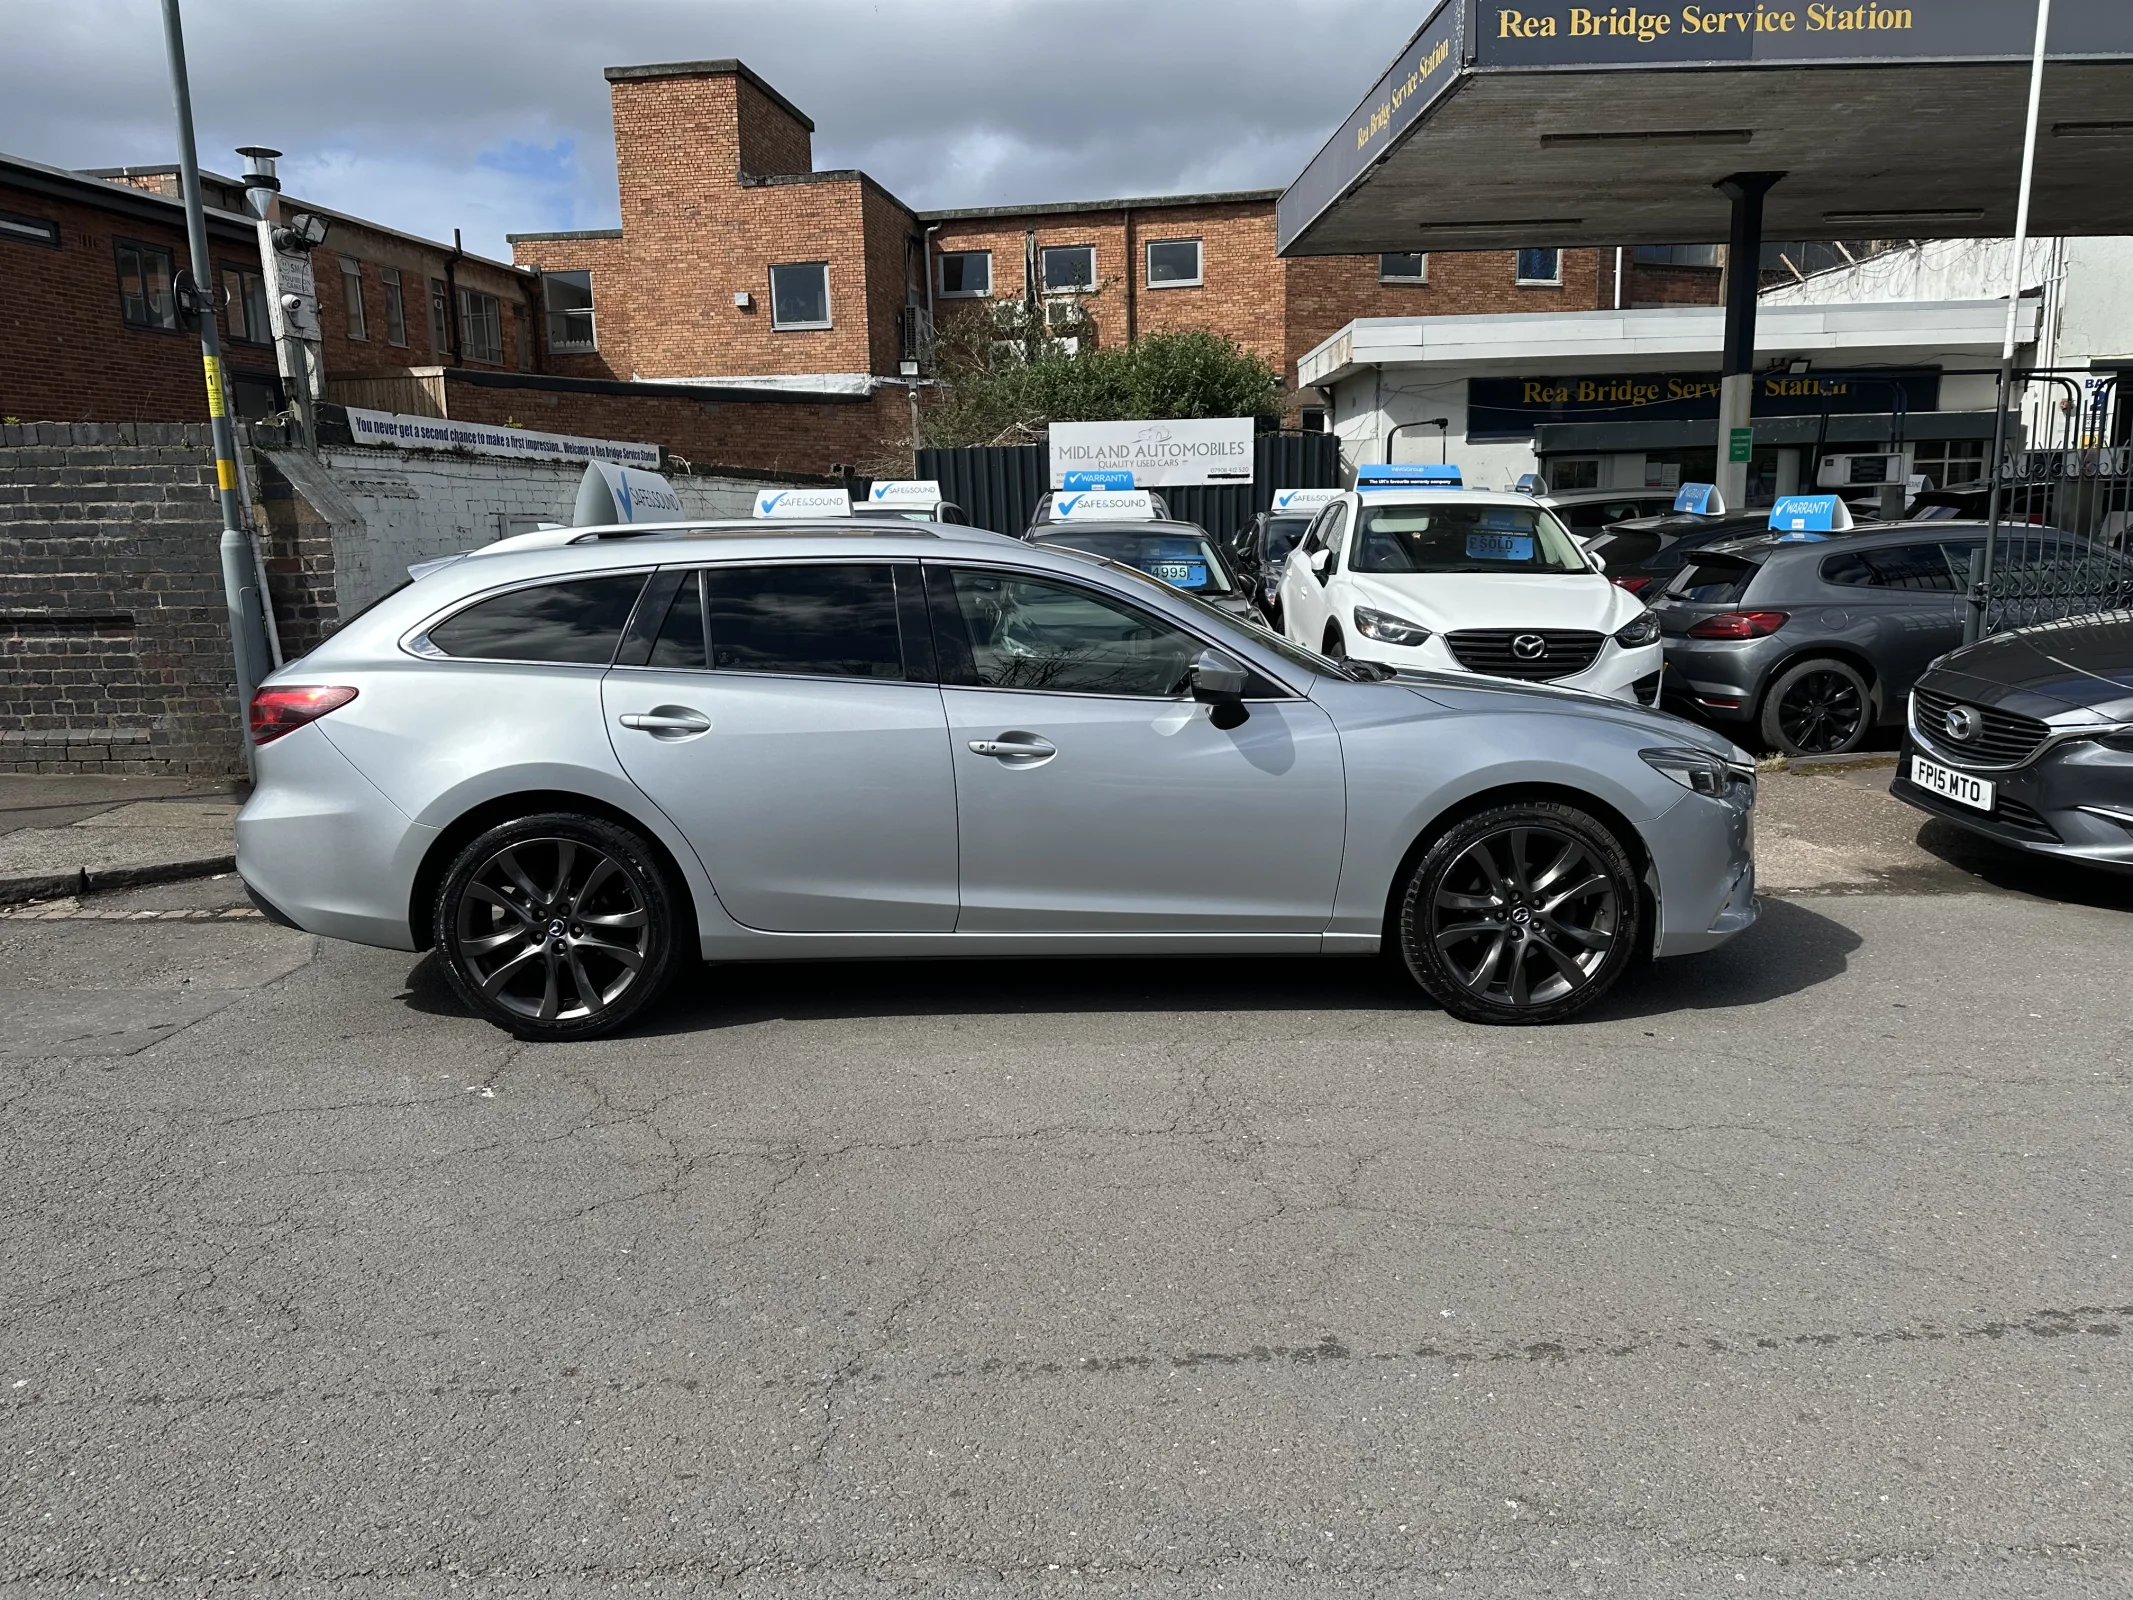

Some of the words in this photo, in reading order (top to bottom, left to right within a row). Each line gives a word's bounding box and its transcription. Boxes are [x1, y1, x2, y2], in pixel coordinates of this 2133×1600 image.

[1497, 9, 1557, 38] Rea
[1568, 7, 1671, 43] Bridge
[1681, 4, 1796, 35] Service
[1806, 2, 1913, 32] Station
[1357, 127, 1369, 151] Rea
[1370, 102, 1391, 130] Bridge
[1392, 71, 1418, 113] Service
[1420, 38, 1449, 83] Station
[207, 374, 213, 386] 1
[2085, 379, 2111, 389] BA
[1522, 382, 1569, 403] Rea
[1577, 380, 1659, 406] Bridge
[1667, 378, 1754, 399] Serv
[1765, 379, 1847, 397] Statin
[356, 416, 372, 433] You
[374, 421, 397, 436] never
[399, 424, 413, 439] get
[415, 428, 420, 438] a
[421, 427, 449, 442] second
[450, 429, 477, 444] chance
[477, 432, 485, 445] to
[486, 433, 505, 447] make
[505, 438, 510, 448] a
[511, 435, 525, 449] first
[563, 442, 589, 456] Welcome
[589, 445, 596, 456] to
[596, 446, 605, 458] Rea
[606, 447, 622, 460] Bridge
[623, 448, 641, 460] Service
[641, 450, 657, 462] Station
[1059, 444, 1130, 460] MIDLAND
[1135, 442, 1245, 458] AUTOMOBILES
[1098, 460, 1134, 469] QUALITY
[1136, 459, 1156, 468] USED
[1157, 459, 1179, 467] CARS
[1081, 474, 1129, 482] WARRANTY
[888, 486, 936, 494] SAFE&SOUND
[779, 497, 844, 506] SAFE&SOUND
[1078, 499, 1146, 508] SAFE&SOUND
[1293, 494, 1336, 502] SAFE&SOU
[1787, 501, 1831, 514] WARRANTY
[1480, 538, 1514, 550] SOLD
[1151, 567, 1187, 578] 4995
[1918, 761, 1946, 790] FP15
[1949, 773, 1980, 802] MTO
